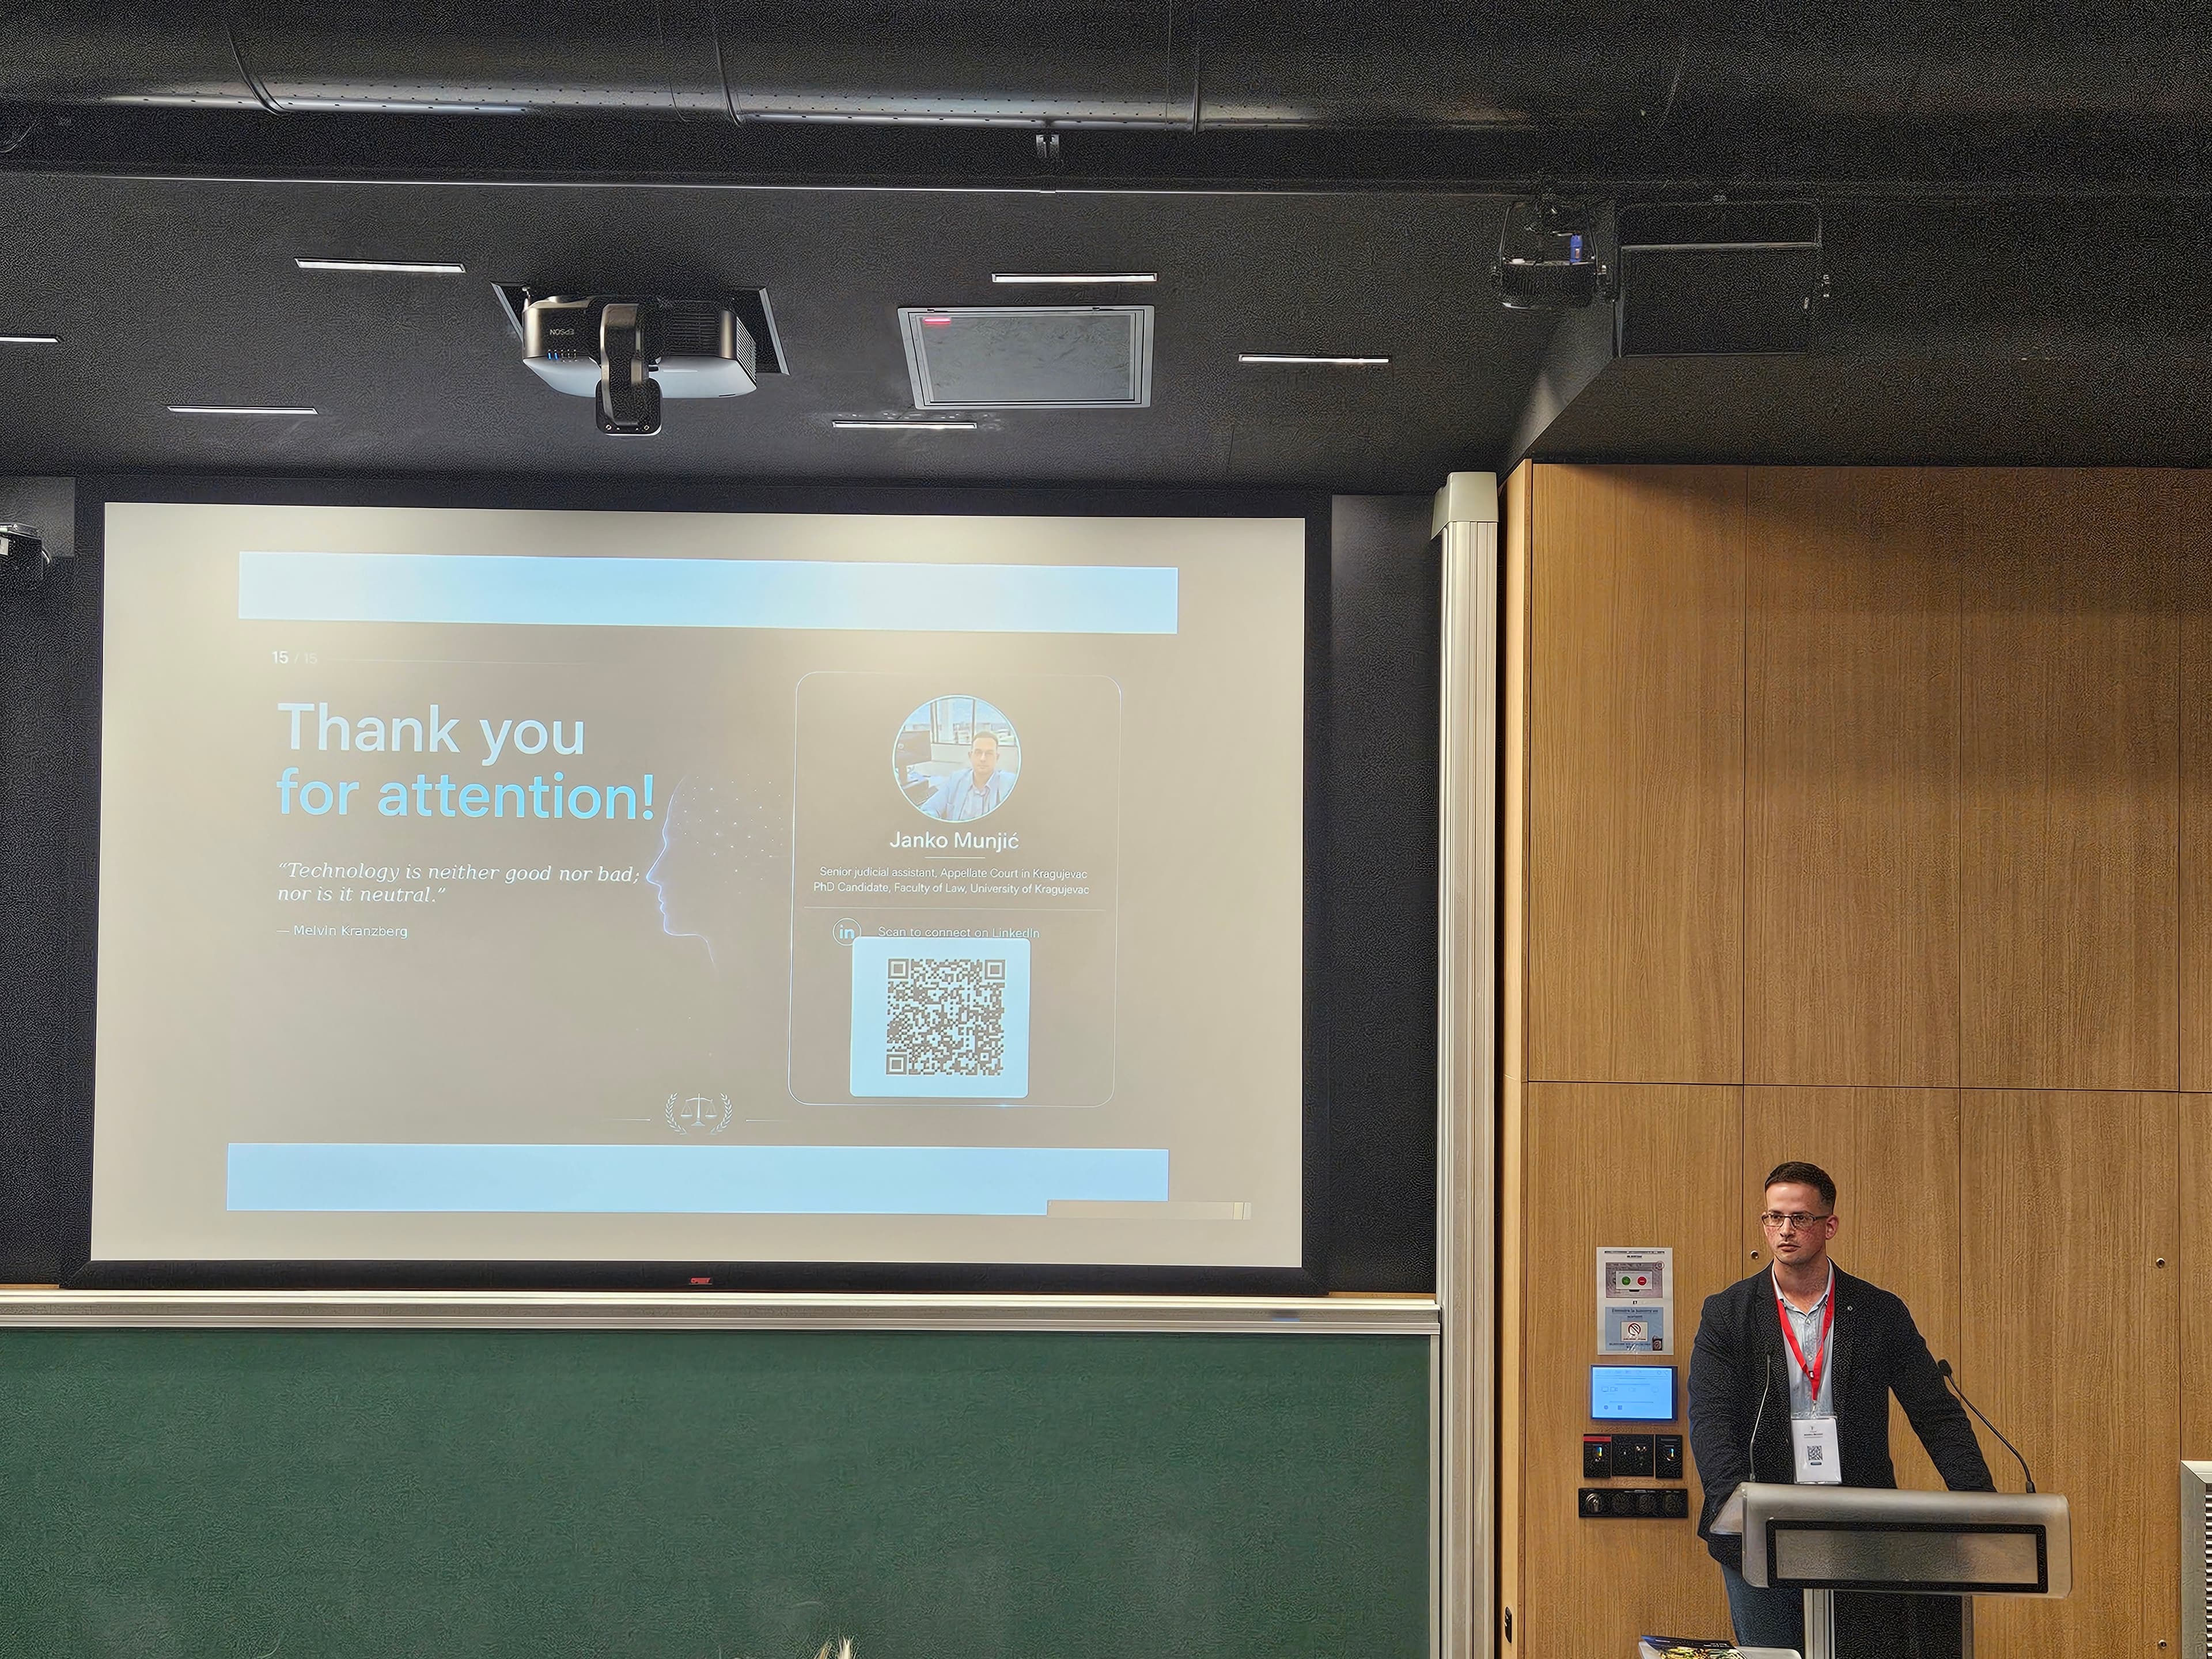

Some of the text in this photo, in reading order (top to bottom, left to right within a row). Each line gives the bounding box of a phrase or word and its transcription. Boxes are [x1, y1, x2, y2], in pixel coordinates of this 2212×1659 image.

[271, 650, 289, 664] 15
[304, 652, 318, 664] 15
[277, 702, 585, 767] Thank you
[275, 766, 654, 820] for attention!
[889, 831, 1020, 853] Janko Munjić
[406, 864, 422, 879] is
[428, 864, 500, 880] neither
[505, 865, 552, 884] good
[559, 868, 593, 881] nor
[597, 865, 640, 884] bad;
[820, 866, 1088, 881] Senior judicial assistant, Appellate Court in Kragujevac
[277, 888, 313, 902] nor
[316, 886, 334, 902] is
[339, 886, 354, 902] it
[813, 881, 1090, 897] PhD Candidate, Faculty of Law, University of Kragujevac
[293, 925, 337, 936] Melvin
[341, 925, 408, 940] Kranzberg
[839, 924, 855, 940] in
[878, 926, 1040, 938] Scan to connect on LinkedIn
